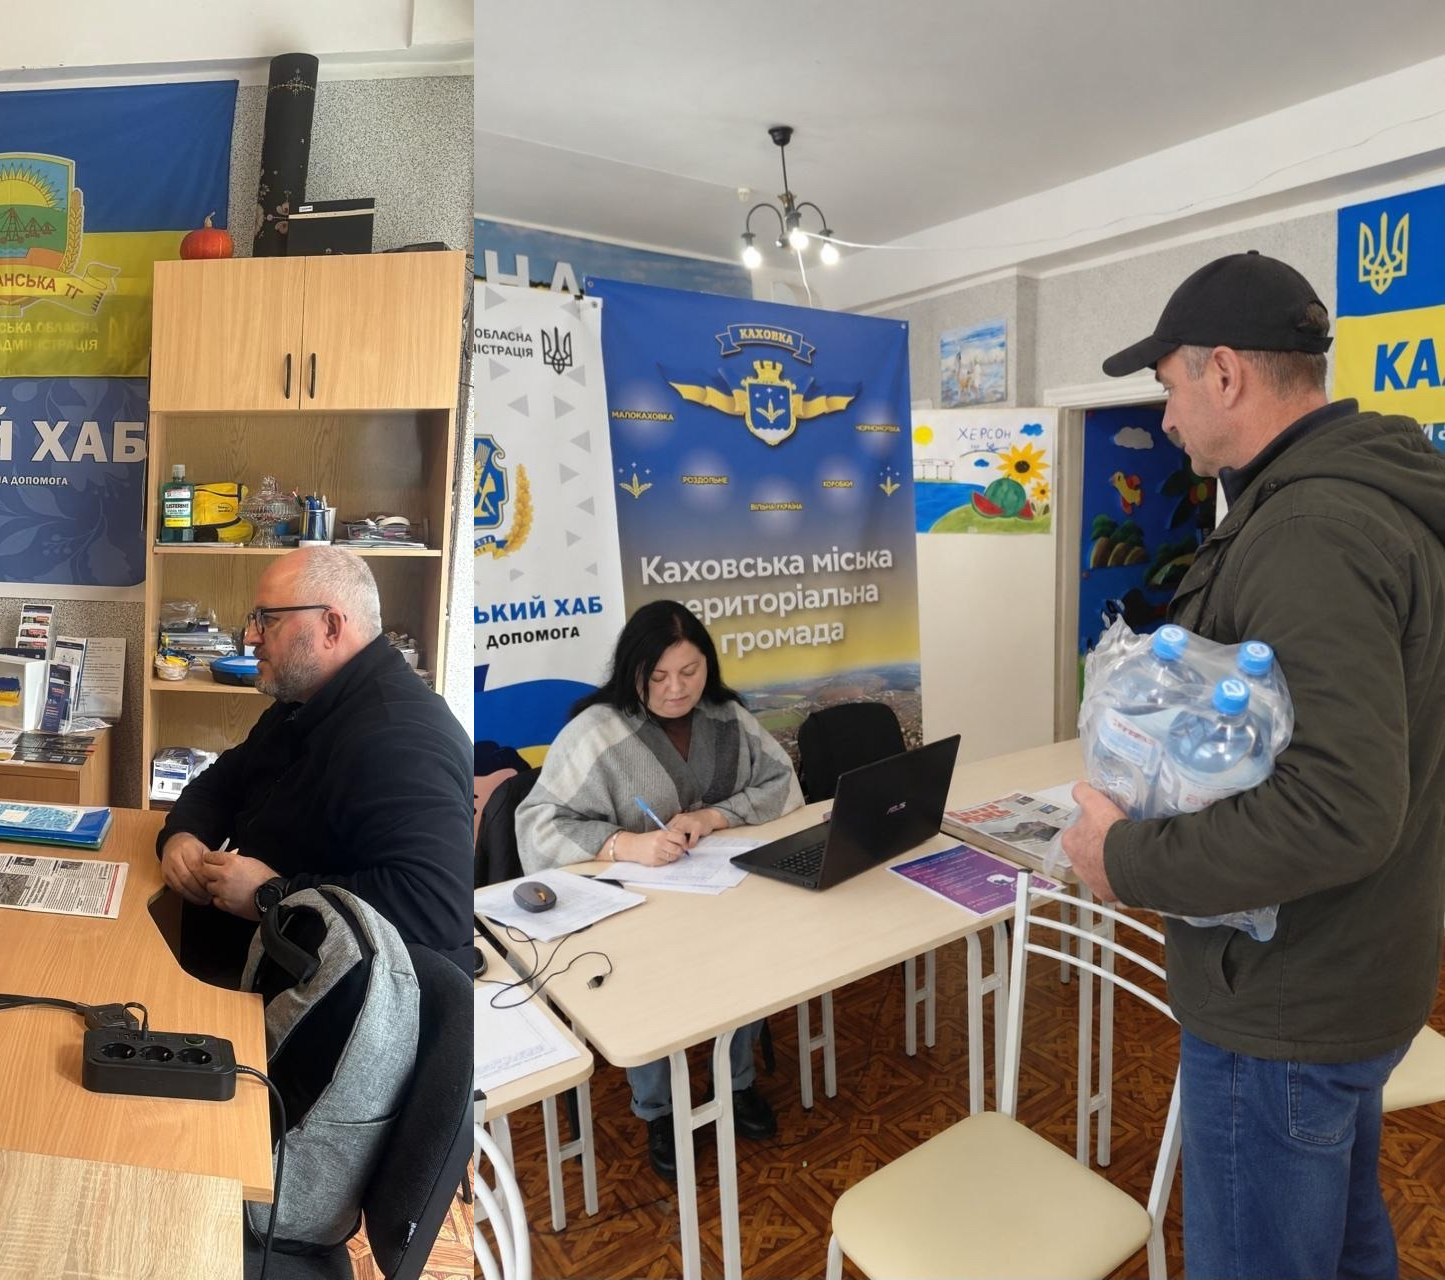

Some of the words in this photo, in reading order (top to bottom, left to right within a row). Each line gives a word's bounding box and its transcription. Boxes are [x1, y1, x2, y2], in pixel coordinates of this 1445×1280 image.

[64, 283, 84, 299] ТГ
[474, 328, 533, 343] ОБЛАСНА
[739, 327, 793, 345] КАХОВКА
[612, 411, 674, 421] МАЛОКАХОВКА
[31, 420, 147, 463] ХАБ
[958, 427, 1011, 441] ХЕРСОН
[10, 476, 68, 486] ДОПОМОГА
[682, 476, 729, 485] РОЗДОЛЬНЕ
[641, 554, 804, 585] Каховська
[812, 546, 893, 573] міська
[554, 596, 603, 617] ХАБ
[682, 583, 879, 626] ериторіальна
[486, 626, 580, 650] ДОПОМОГА
[721, 622, 844, 658] громада
